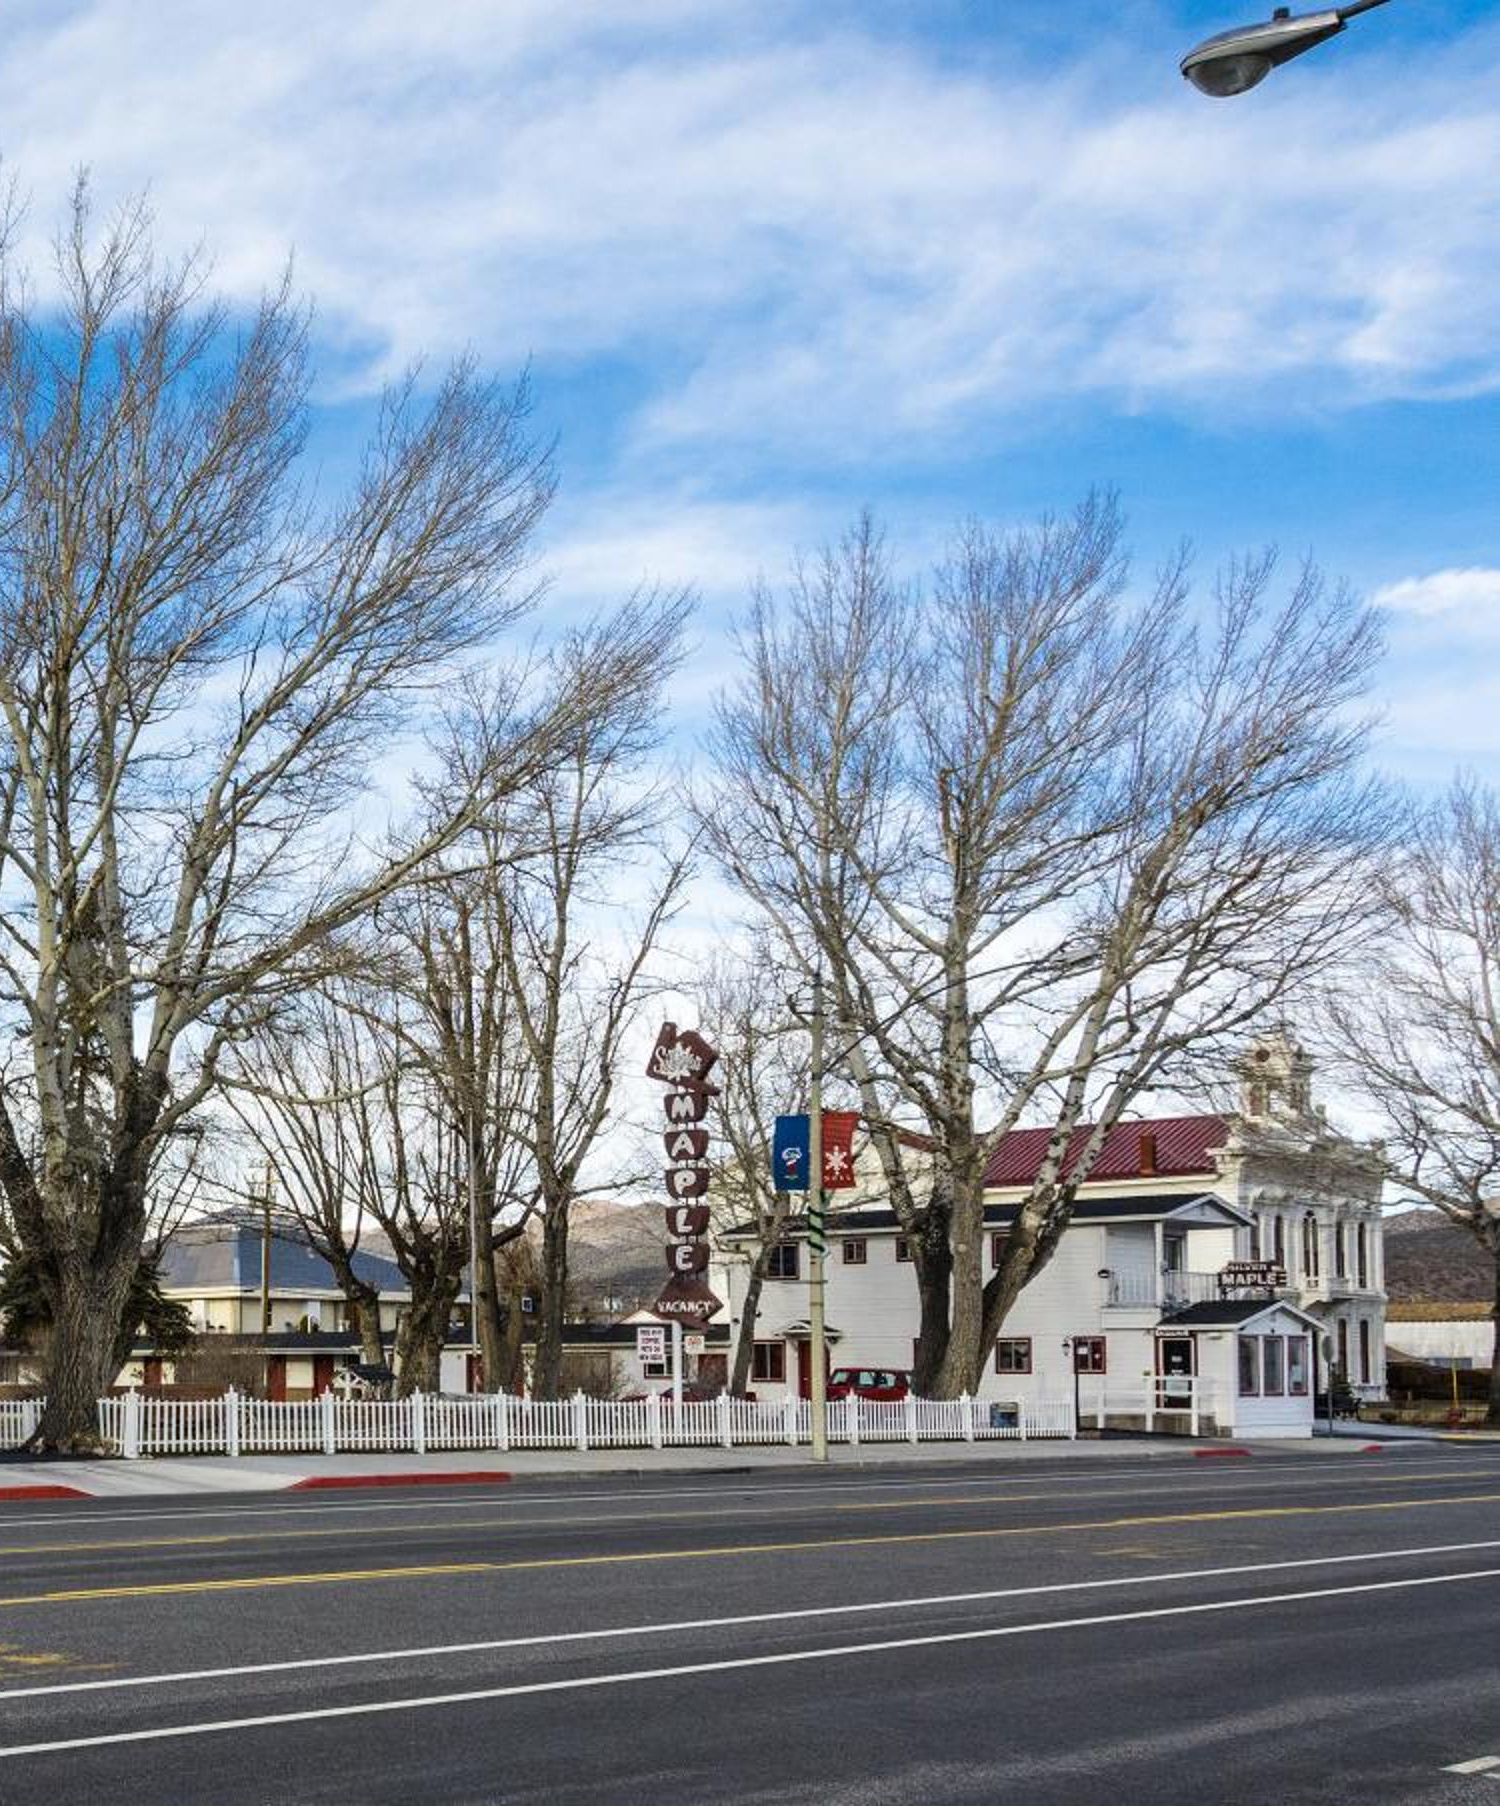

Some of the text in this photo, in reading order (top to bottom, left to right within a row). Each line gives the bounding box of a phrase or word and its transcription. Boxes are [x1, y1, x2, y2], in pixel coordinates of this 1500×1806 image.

[670, 1095, 698, 1271] MAPLE
[1221, 1272, 1277, 1285] MAPLE
[657, 1301, 713, 1314] VACANCY
